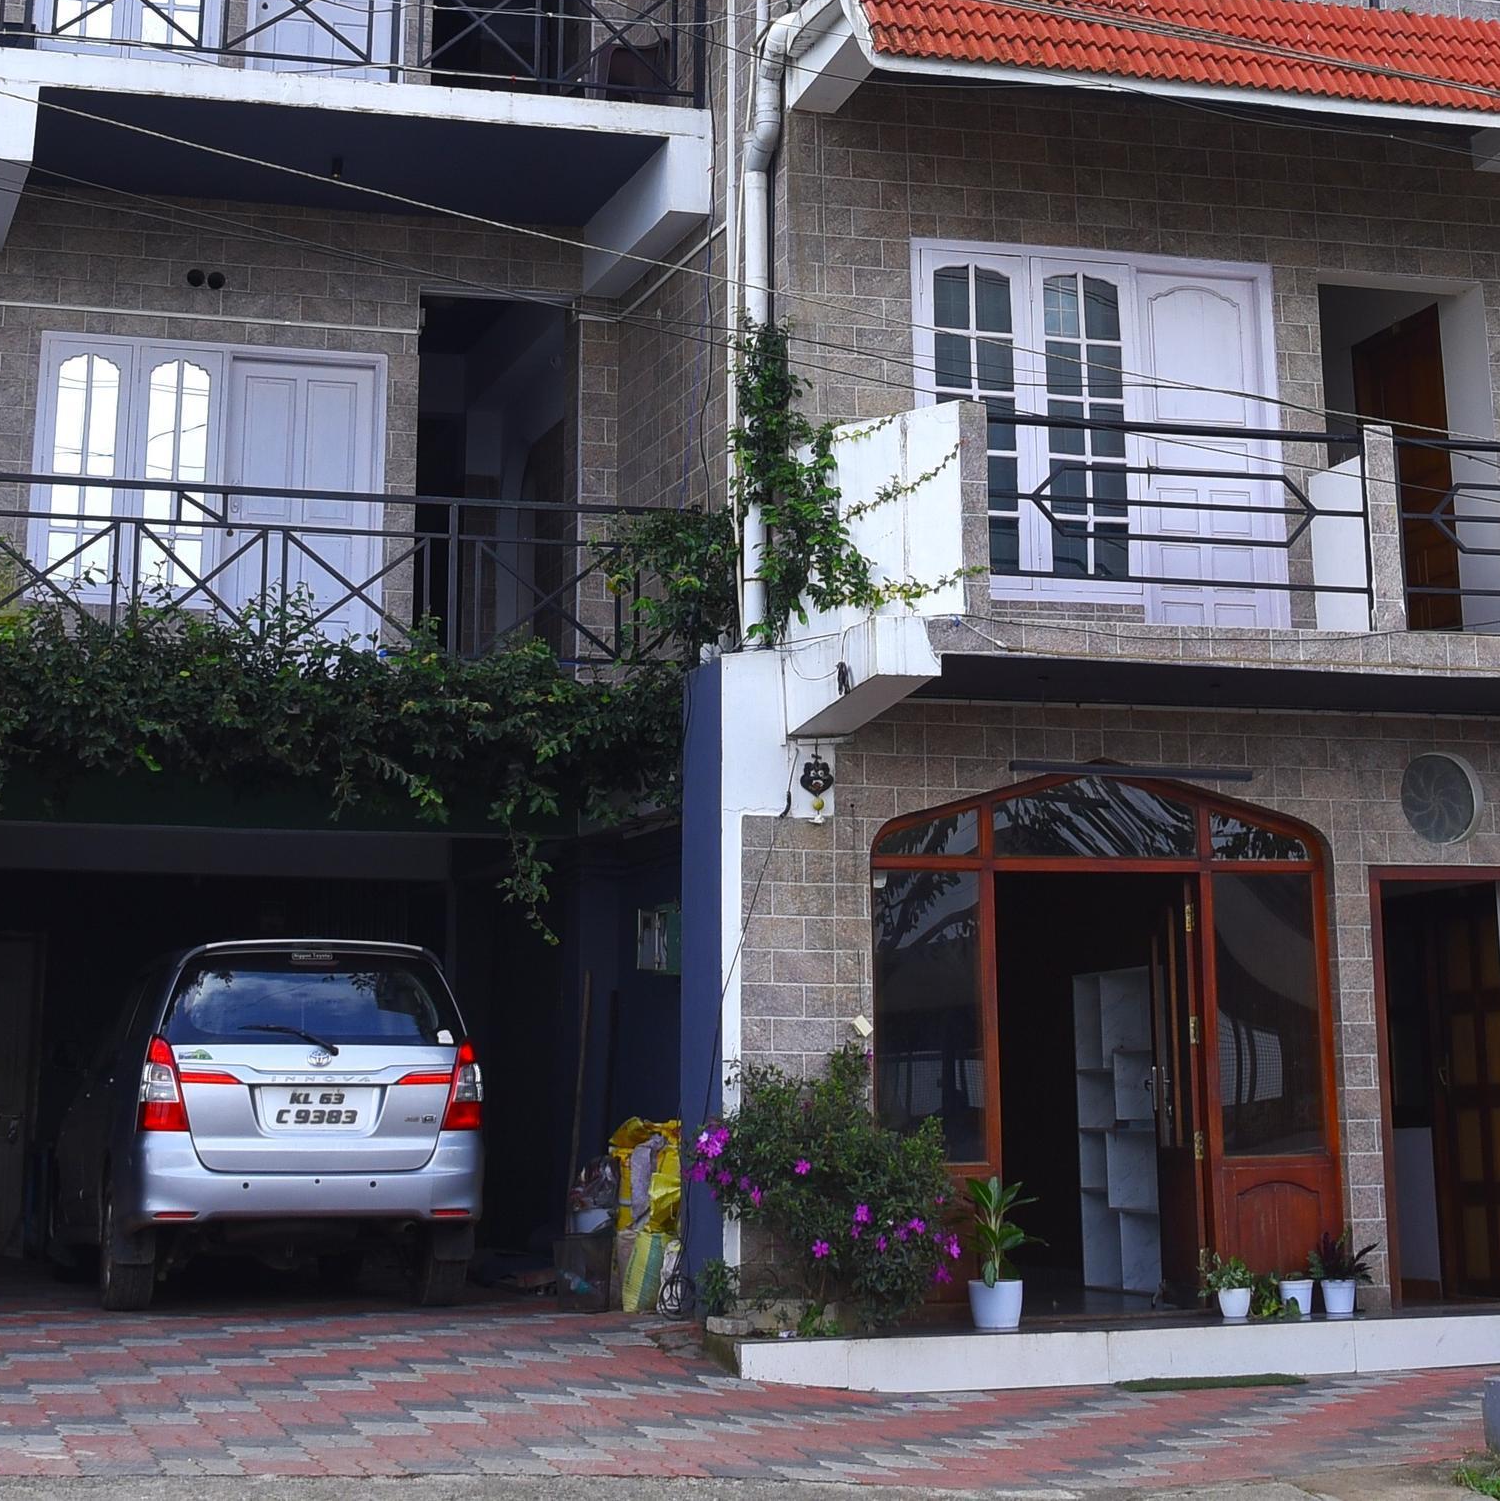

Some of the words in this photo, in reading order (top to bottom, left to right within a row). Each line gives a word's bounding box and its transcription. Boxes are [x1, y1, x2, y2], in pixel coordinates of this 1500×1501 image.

[289, 1092, 313, 1105] KL
[319, 1092, 345, 1105] 63
[275, 1109, 291, 1124] C
[293, 1109, 358, 1125] 9383
